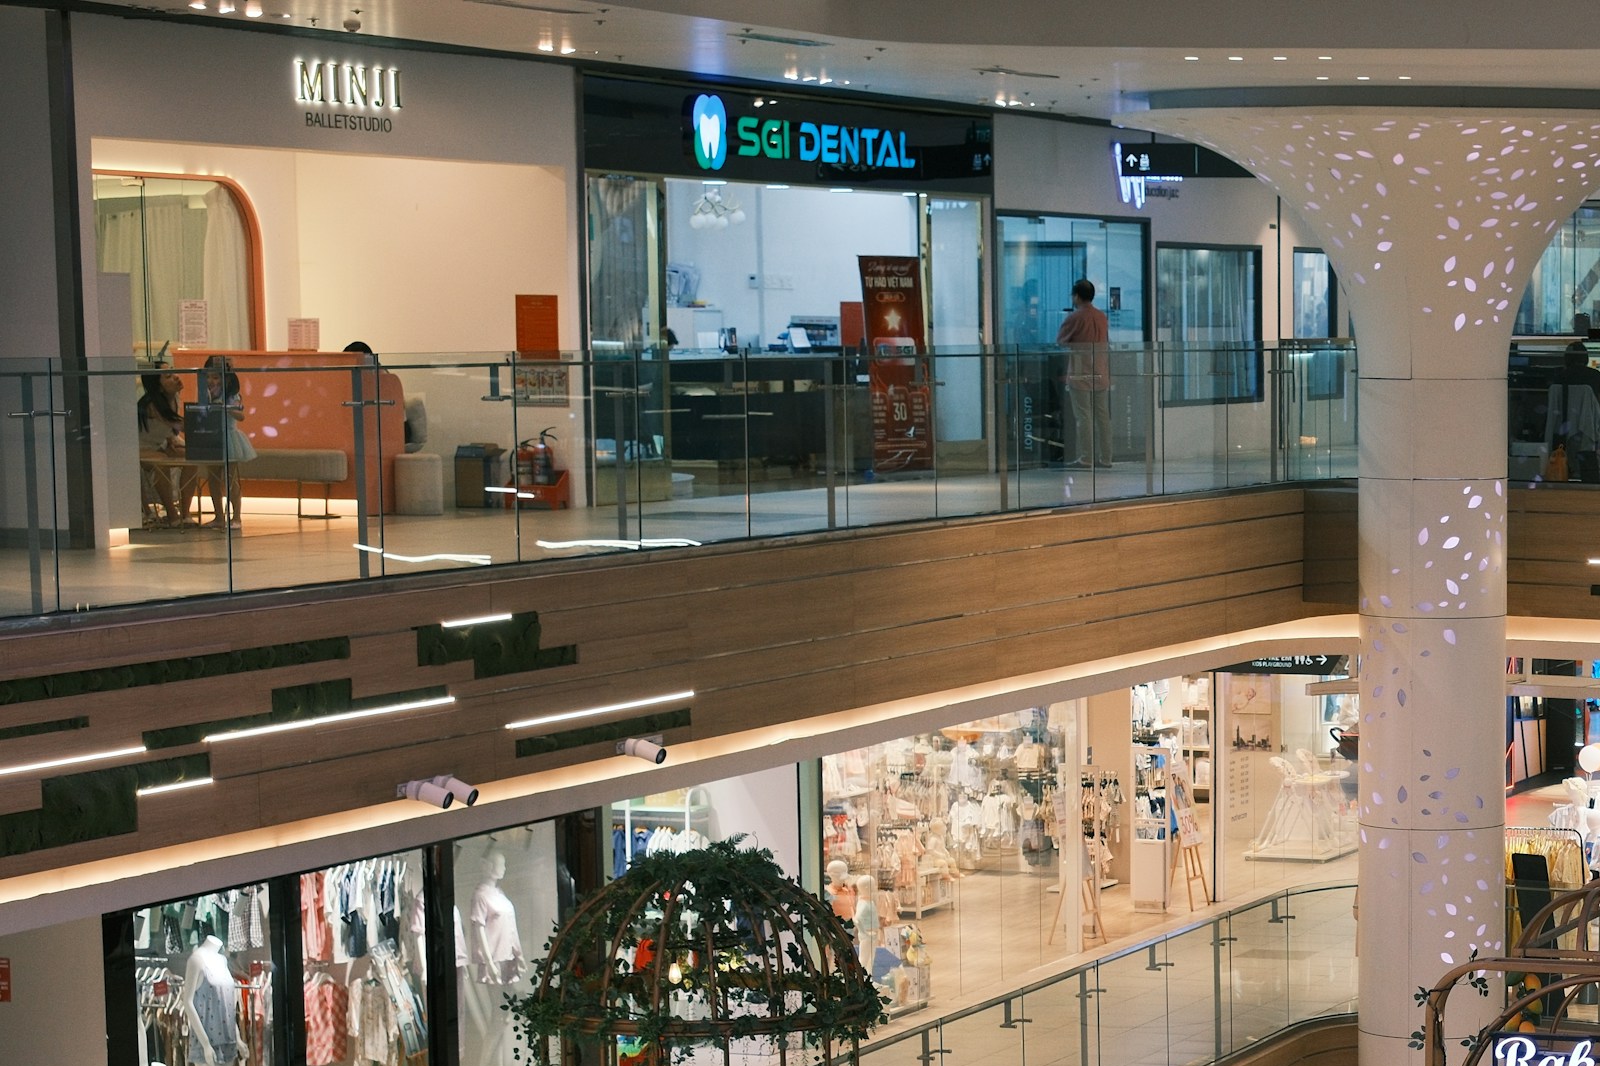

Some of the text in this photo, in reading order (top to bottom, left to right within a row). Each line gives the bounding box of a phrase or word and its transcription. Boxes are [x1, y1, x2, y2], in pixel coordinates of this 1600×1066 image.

[295, 59, 403, 108] MINJI
[305, 112, 392, 133] BALLETSTUDIO
[737, 116, 915, 168] SGI DENTAL
[893, 402, 908, 420] 30
[1024, 418, 1032, 450] ROBOT
